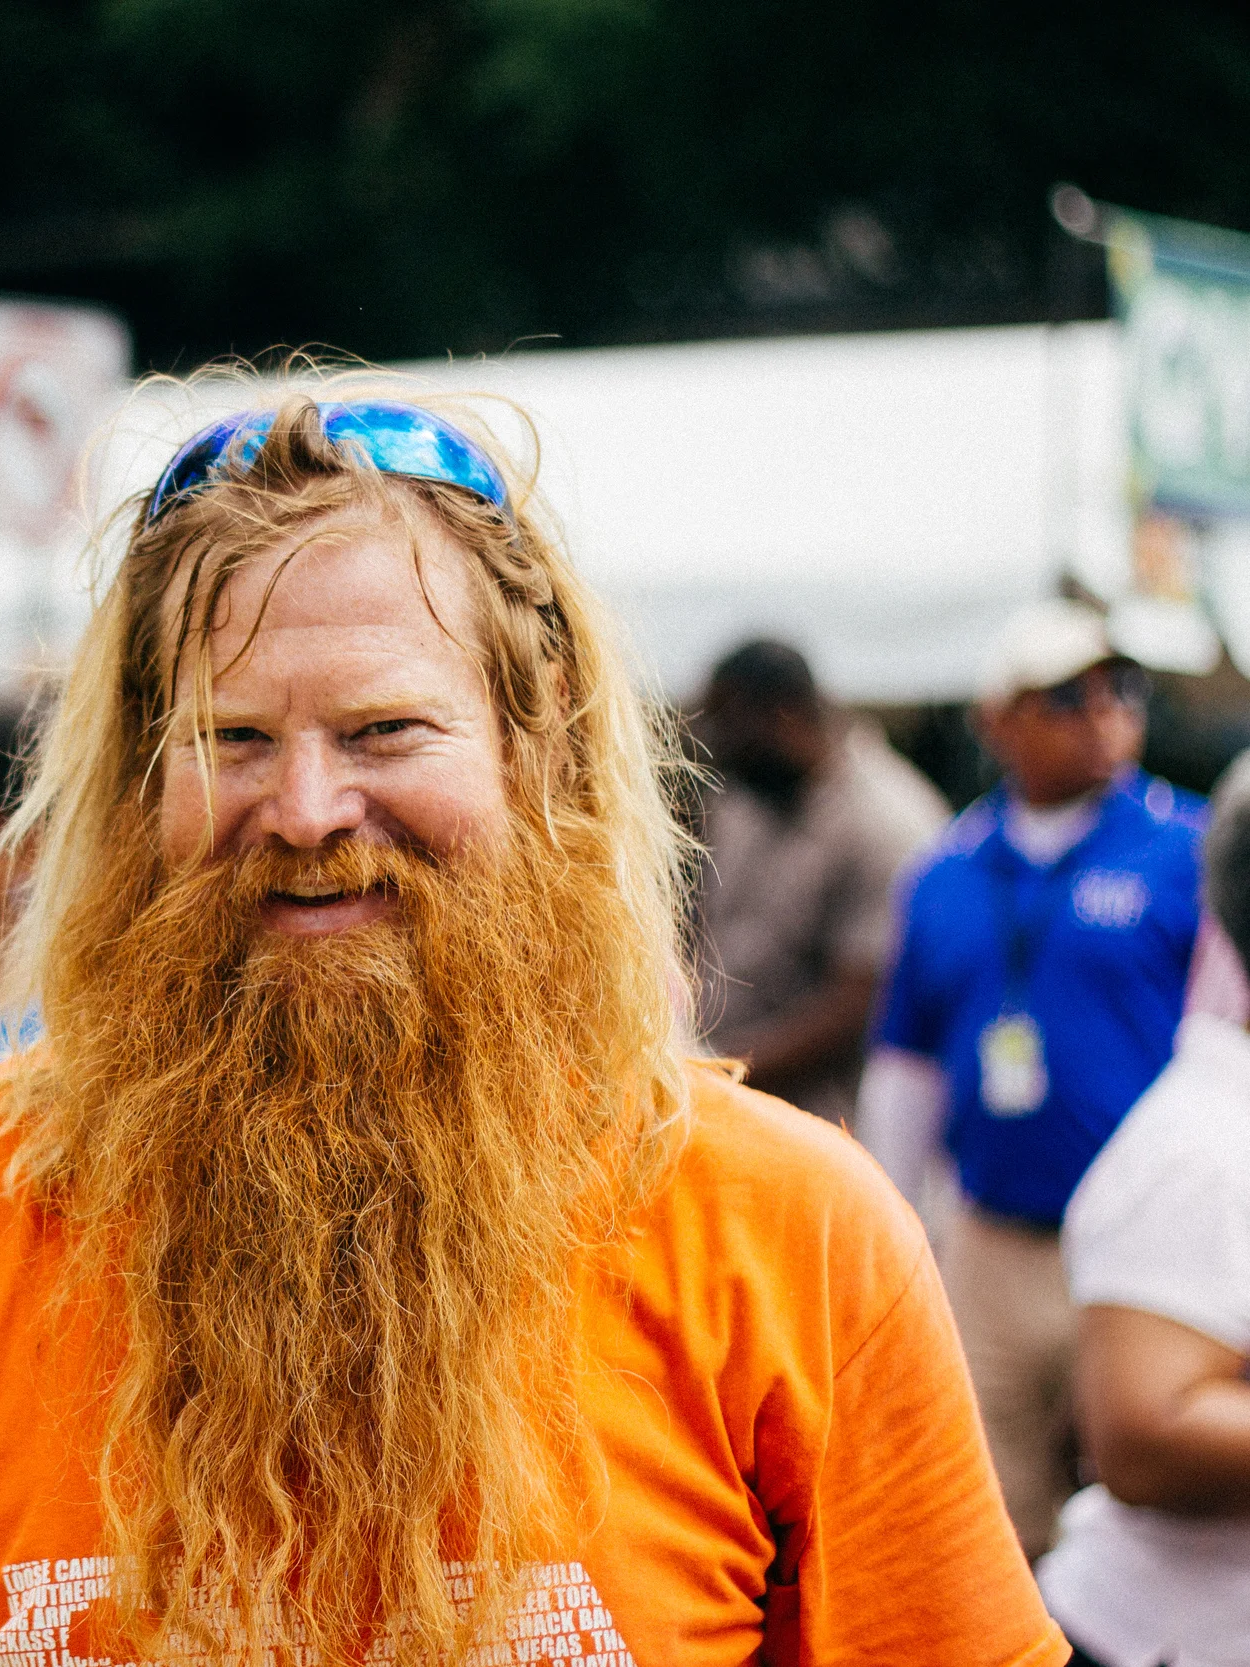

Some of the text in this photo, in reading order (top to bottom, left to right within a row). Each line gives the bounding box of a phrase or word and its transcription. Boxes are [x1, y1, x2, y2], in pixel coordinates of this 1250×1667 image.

[2, 1555, 136, 1595] LOOSE CANN
[505, 1609, 576, 1641] SNACK
[516, 1633, 581, 1663] VEGAS
